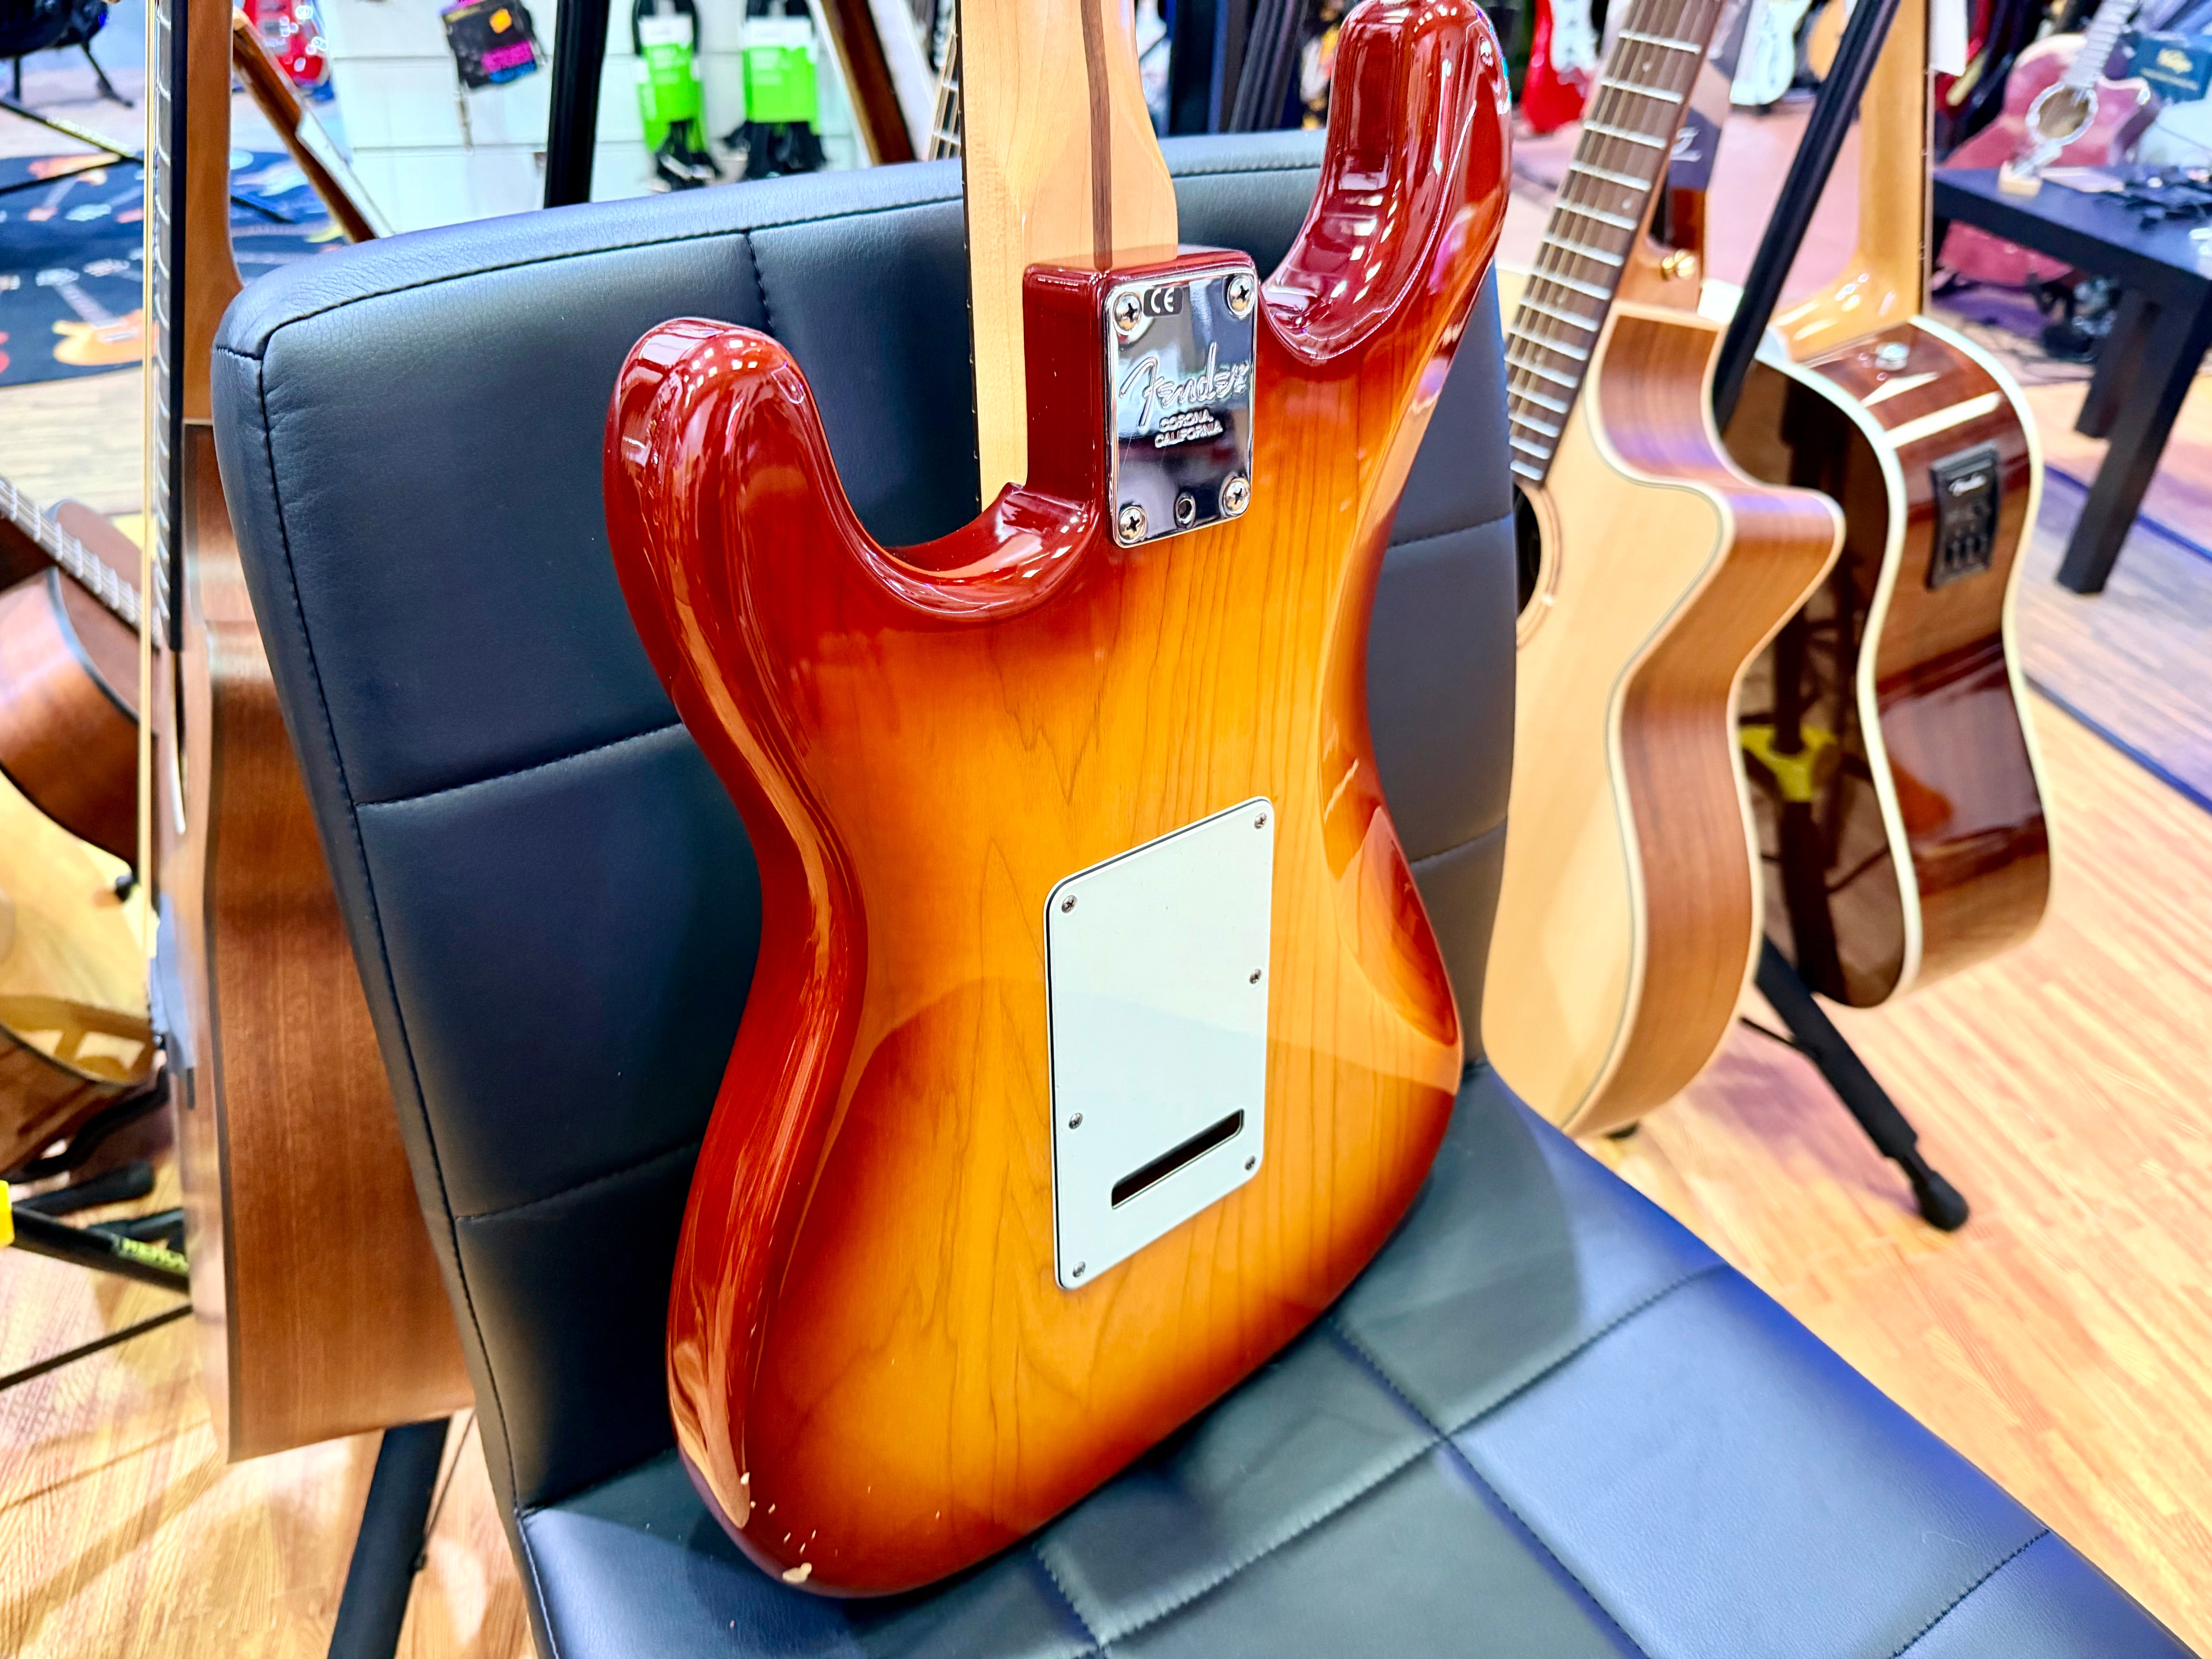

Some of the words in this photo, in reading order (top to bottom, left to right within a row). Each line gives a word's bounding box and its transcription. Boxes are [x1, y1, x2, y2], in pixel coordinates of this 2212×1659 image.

[1151, 287, 1175, 314] CE
[1119, 341, 1249, 429] Fender
[1155, 419, 1224, 448] CALIFORNIA
